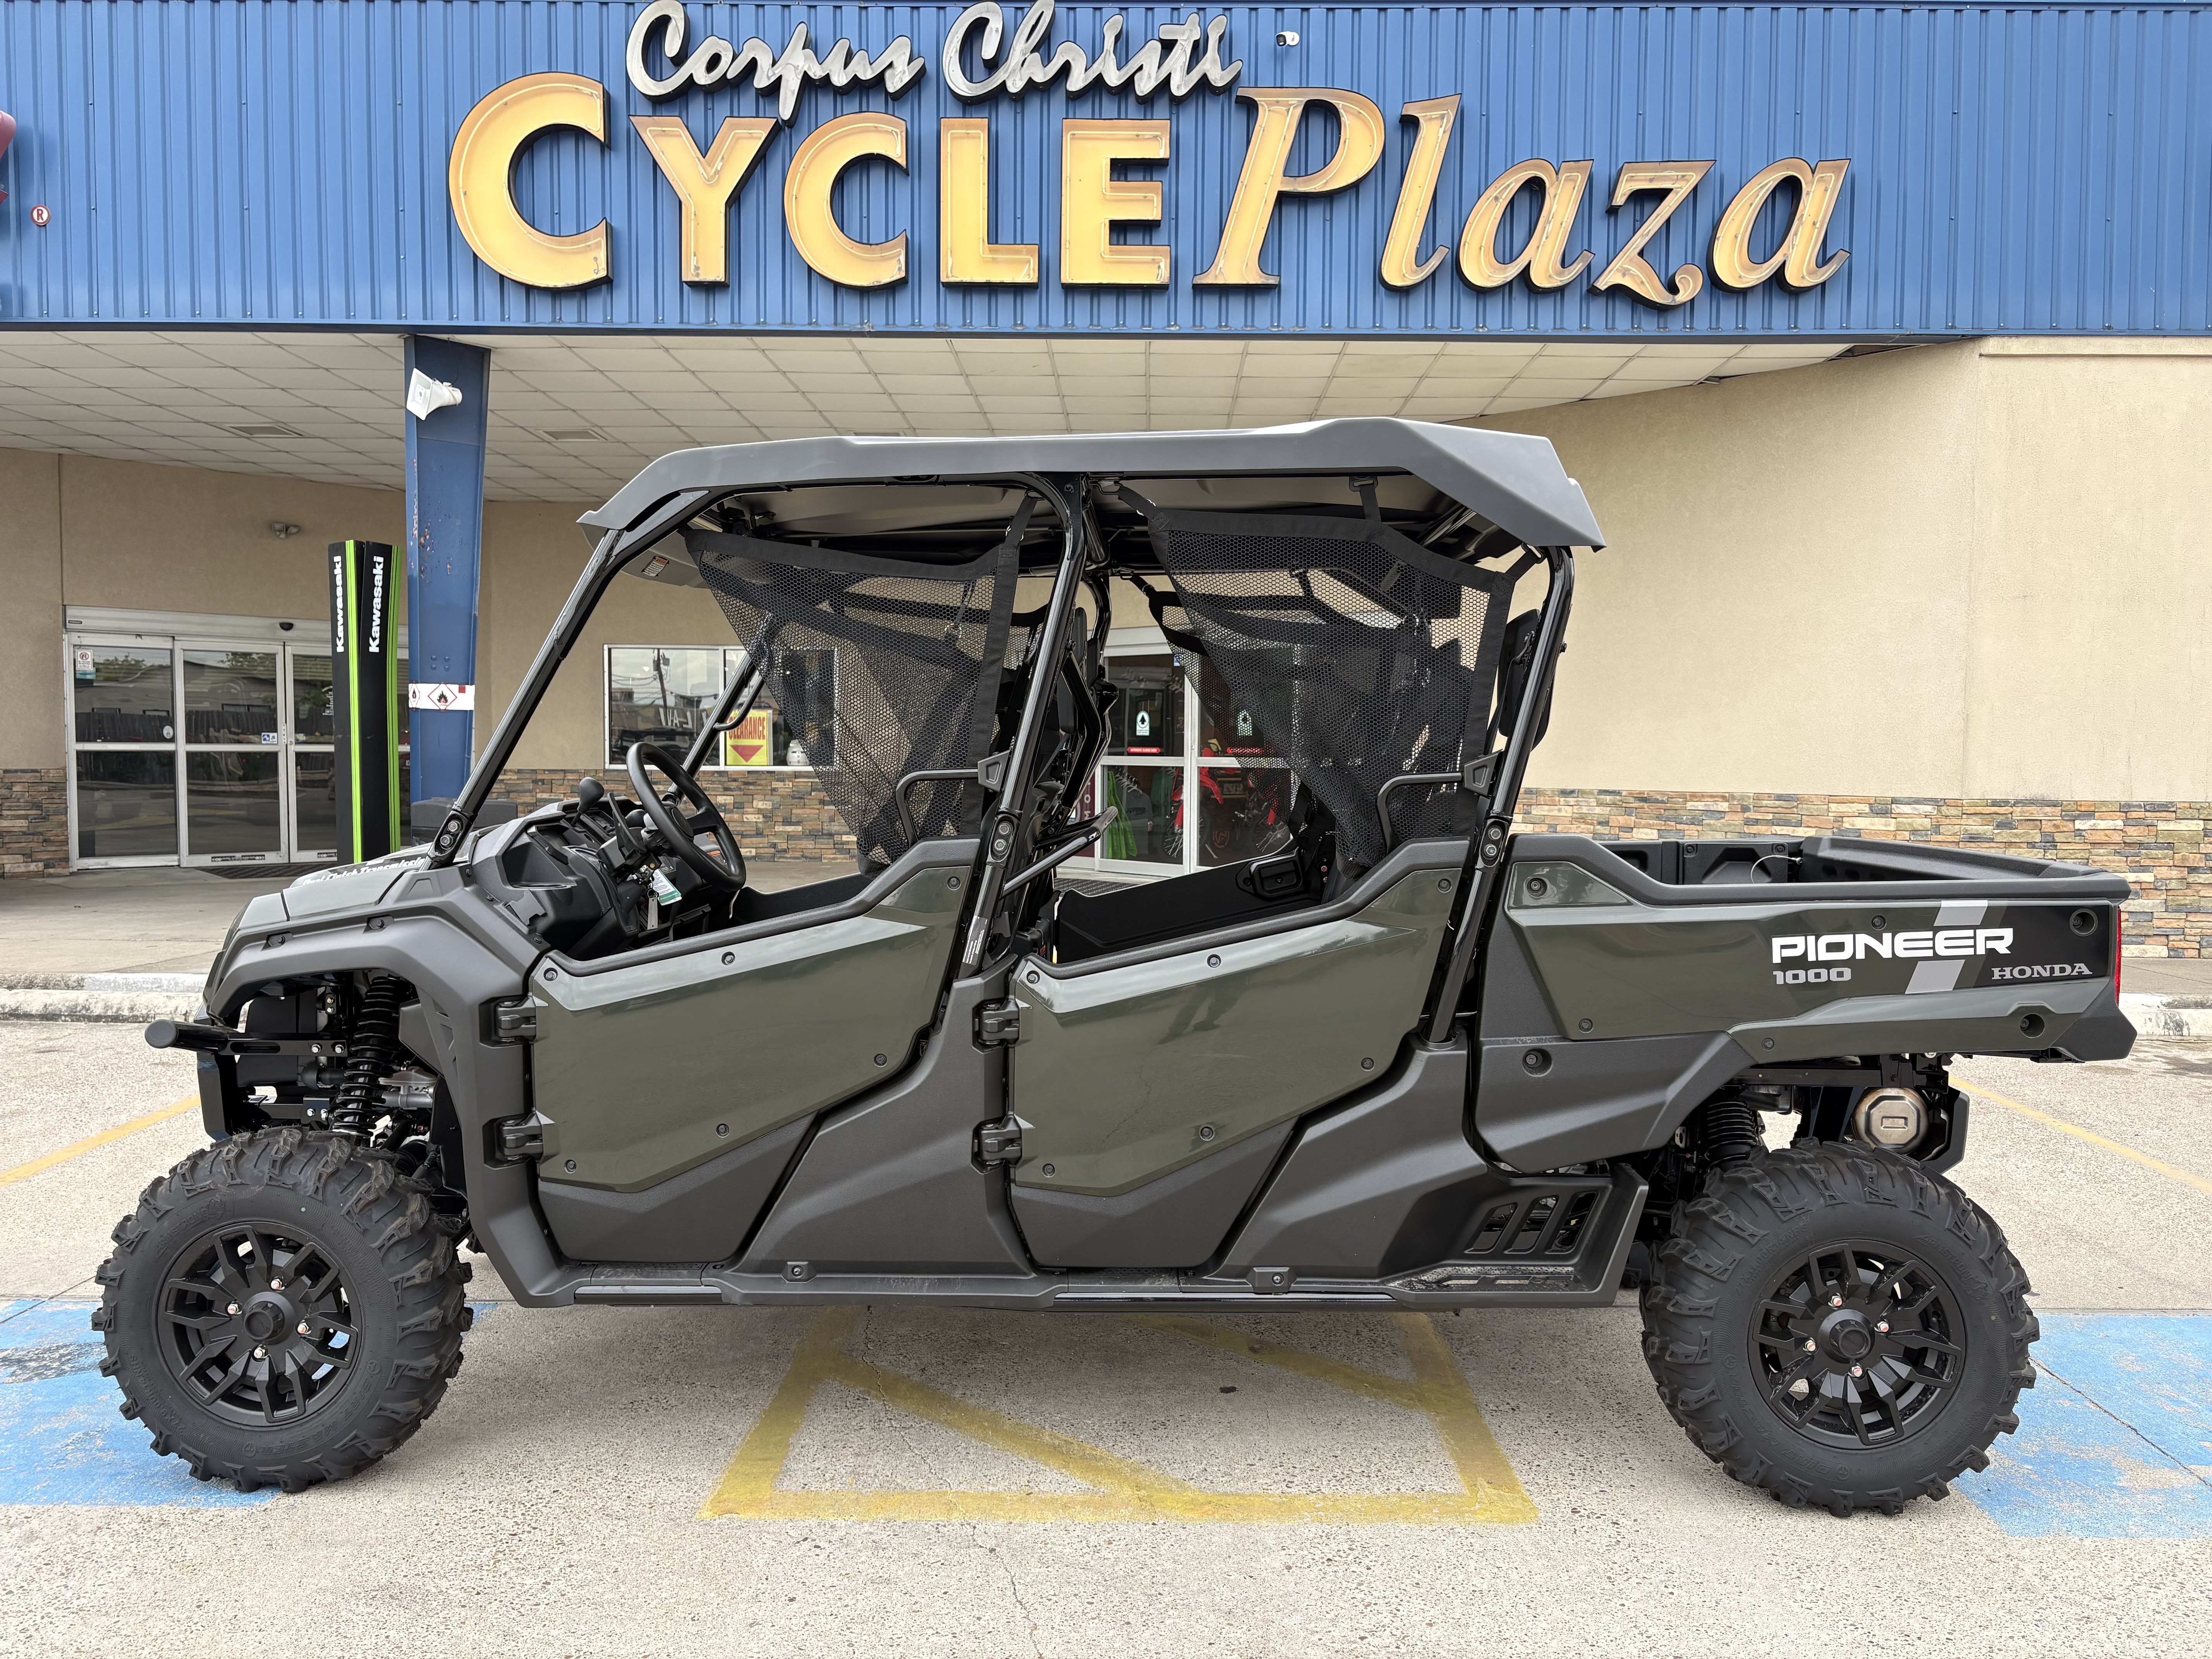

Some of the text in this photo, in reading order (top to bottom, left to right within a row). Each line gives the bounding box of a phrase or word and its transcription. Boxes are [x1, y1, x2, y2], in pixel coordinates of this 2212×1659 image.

[626, 0, 1243, 127] Corpus Christi
[448, 71, 1851, 310] CYCLE Plaza
[334, 556, 344, 653] Kawasaki
[369, 556, 384, 653] Kawasaki
[360, 857, 426, 874] Transmissio
[1771, 928, 2013, 963] PIONEER
[1772, 967, 1851, 984] 1000
[1991, 963, 2093, 980] HONDA
